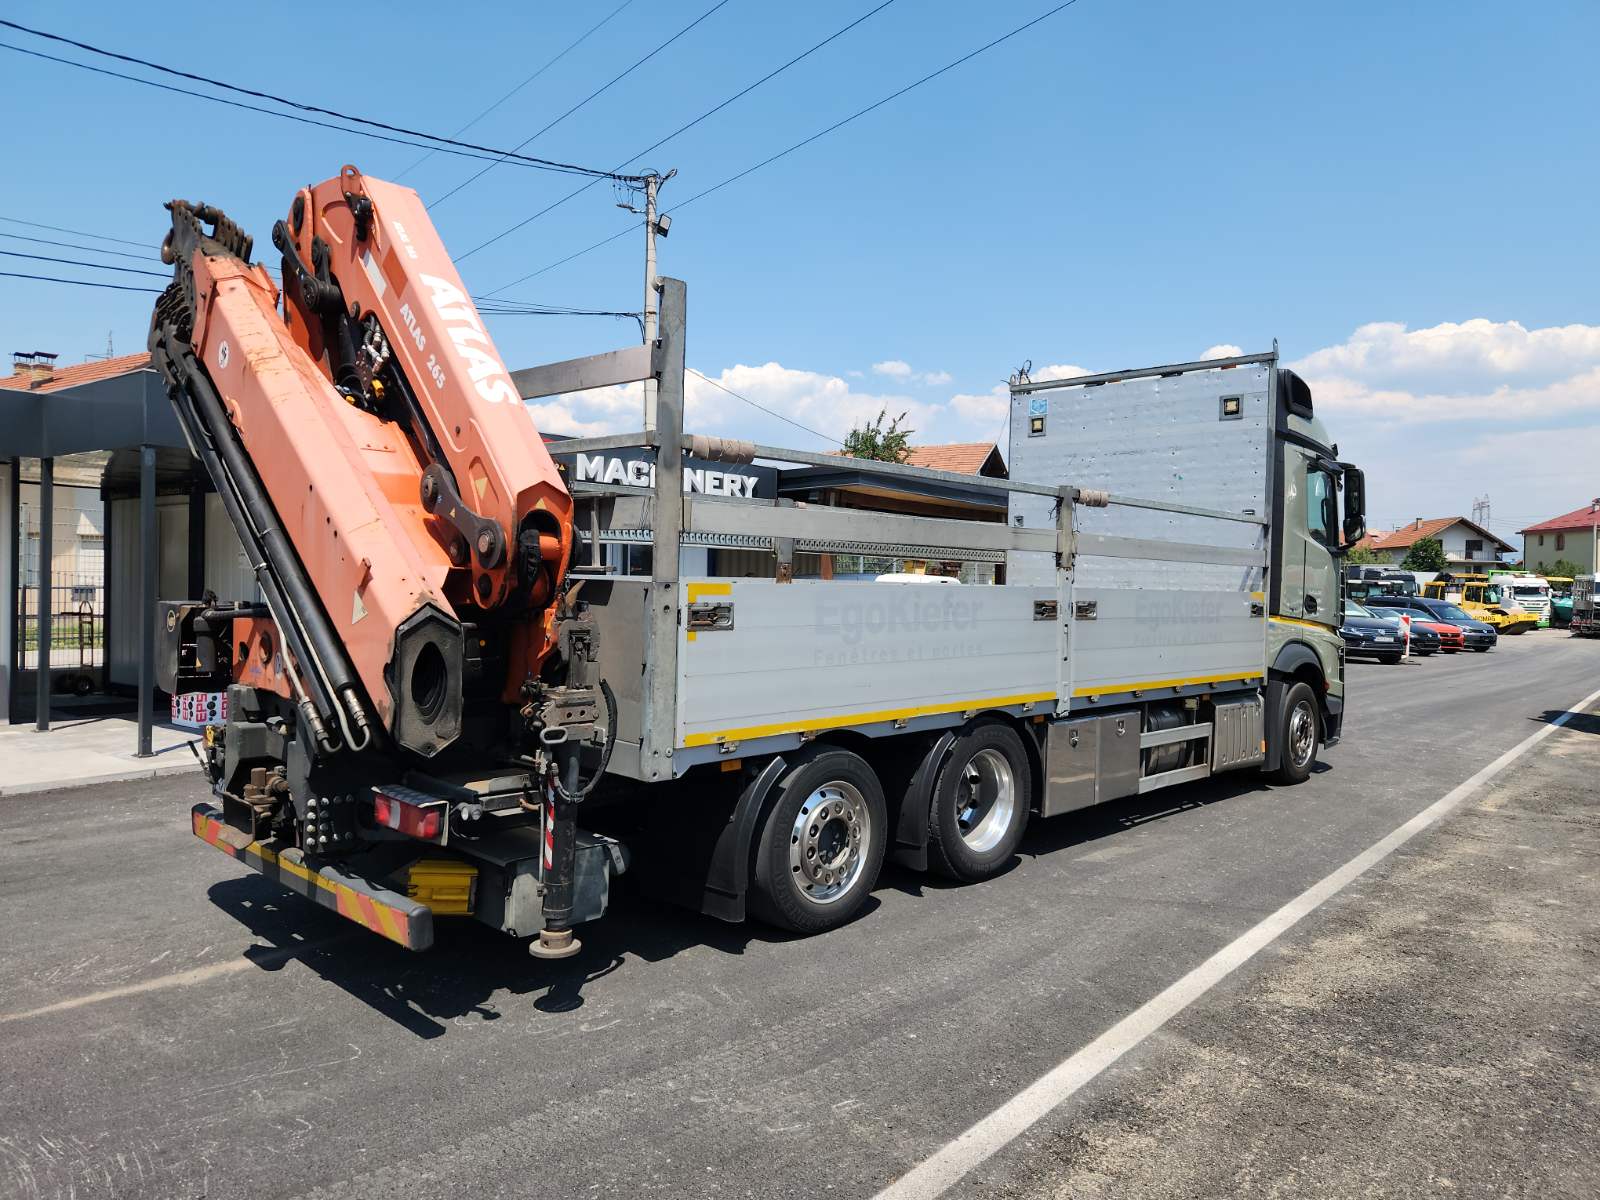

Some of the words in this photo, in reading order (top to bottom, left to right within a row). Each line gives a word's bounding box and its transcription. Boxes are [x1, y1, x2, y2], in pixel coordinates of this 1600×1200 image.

[400, 303, 427, 352] ATLAS
[425, 354, 447, 390] 265
[419, 272, 519, 405] ATLAS
[576, 453, 759, 498] MACNERY
[815, 591, 984, 645] EgoKiefer
[196, 693, 207, 722] EPS
